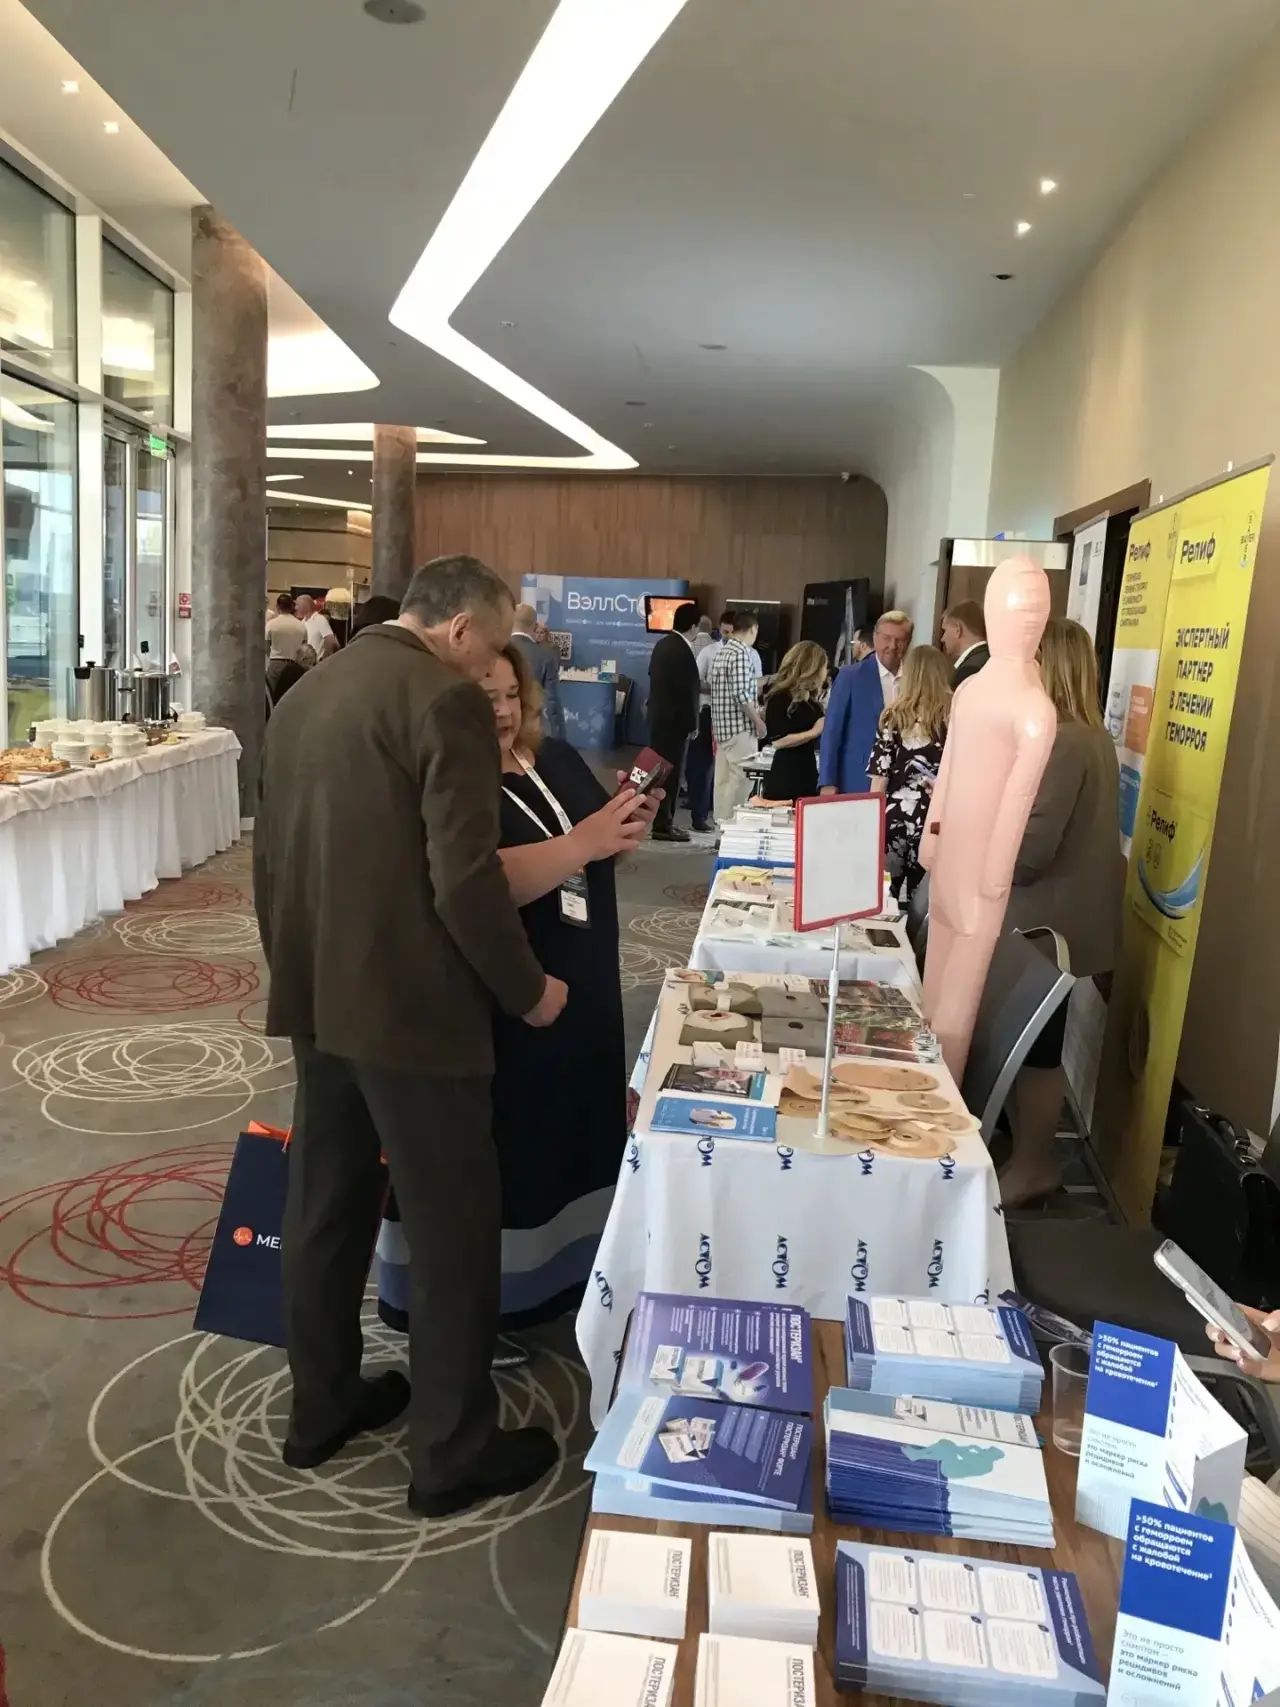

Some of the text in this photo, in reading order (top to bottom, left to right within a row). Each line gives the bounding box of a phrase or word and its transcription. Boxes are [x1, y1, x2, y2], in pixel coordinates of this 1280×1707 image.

[1128, 537, 1151, 562] Релиф
[1180, 532, 1215, 564] Релиф
[567, 591, 645, 619] ВэллСт
[1175, 622, 1230, 649] ЭКСПЕРТНЫЙ
[1177, 659, 1213, 683] ПАРТНЕР
[1169, 690, 1175, 710] В
[1175, 691, 1214, 719] ЛЕЧЕНИИ
[1165, 721, 1207, 752] ГЕМОРРОЯ
[1151, 809, 1175, 844] Релиф
[1098, 1334, 1159, 1357] >50% пациентов
[1103, 1343, 1143, 1360] геморроем
[1094, 1365, 1104, 1373] на
[1096, 1350, 1141, 1368] обращаются
[1101, 1359, 1133, 1373] жалобой
[1085, 1450, 1124, 1468] рецидивов
[1099, 1446, 1126, 1461] маркер
[1127, 1457, 1148, 1468] риска
[1090, 1460, 1135, 1478] осложнений
[1135, 1514, 1214, 1543] >50% пациентов
[1141, 1526, 1193, 1547] геморроем
[1133, 1534, 1191, 1556] обращаются
[1139, 1545, 1180, 1563] жалобой
[1131, 1553, 1142, 1562] на
[1121, 1640, 1160, 1656] симптом
[1123, 1628, 1184, 1654] Это не просто
[1118, 1658, 1168, 1678] рецидивов
[1136, 1654, 1170, 1669] маркер
[1171, 1664, 1198, 1677] риска
[643, 1657, 665, 1707] ПОСТЕРИЗА
[792, 1658, 806, 1707] ПОСТЕРИЗА
[1125, 1670, 1181, 1690] осложнений
